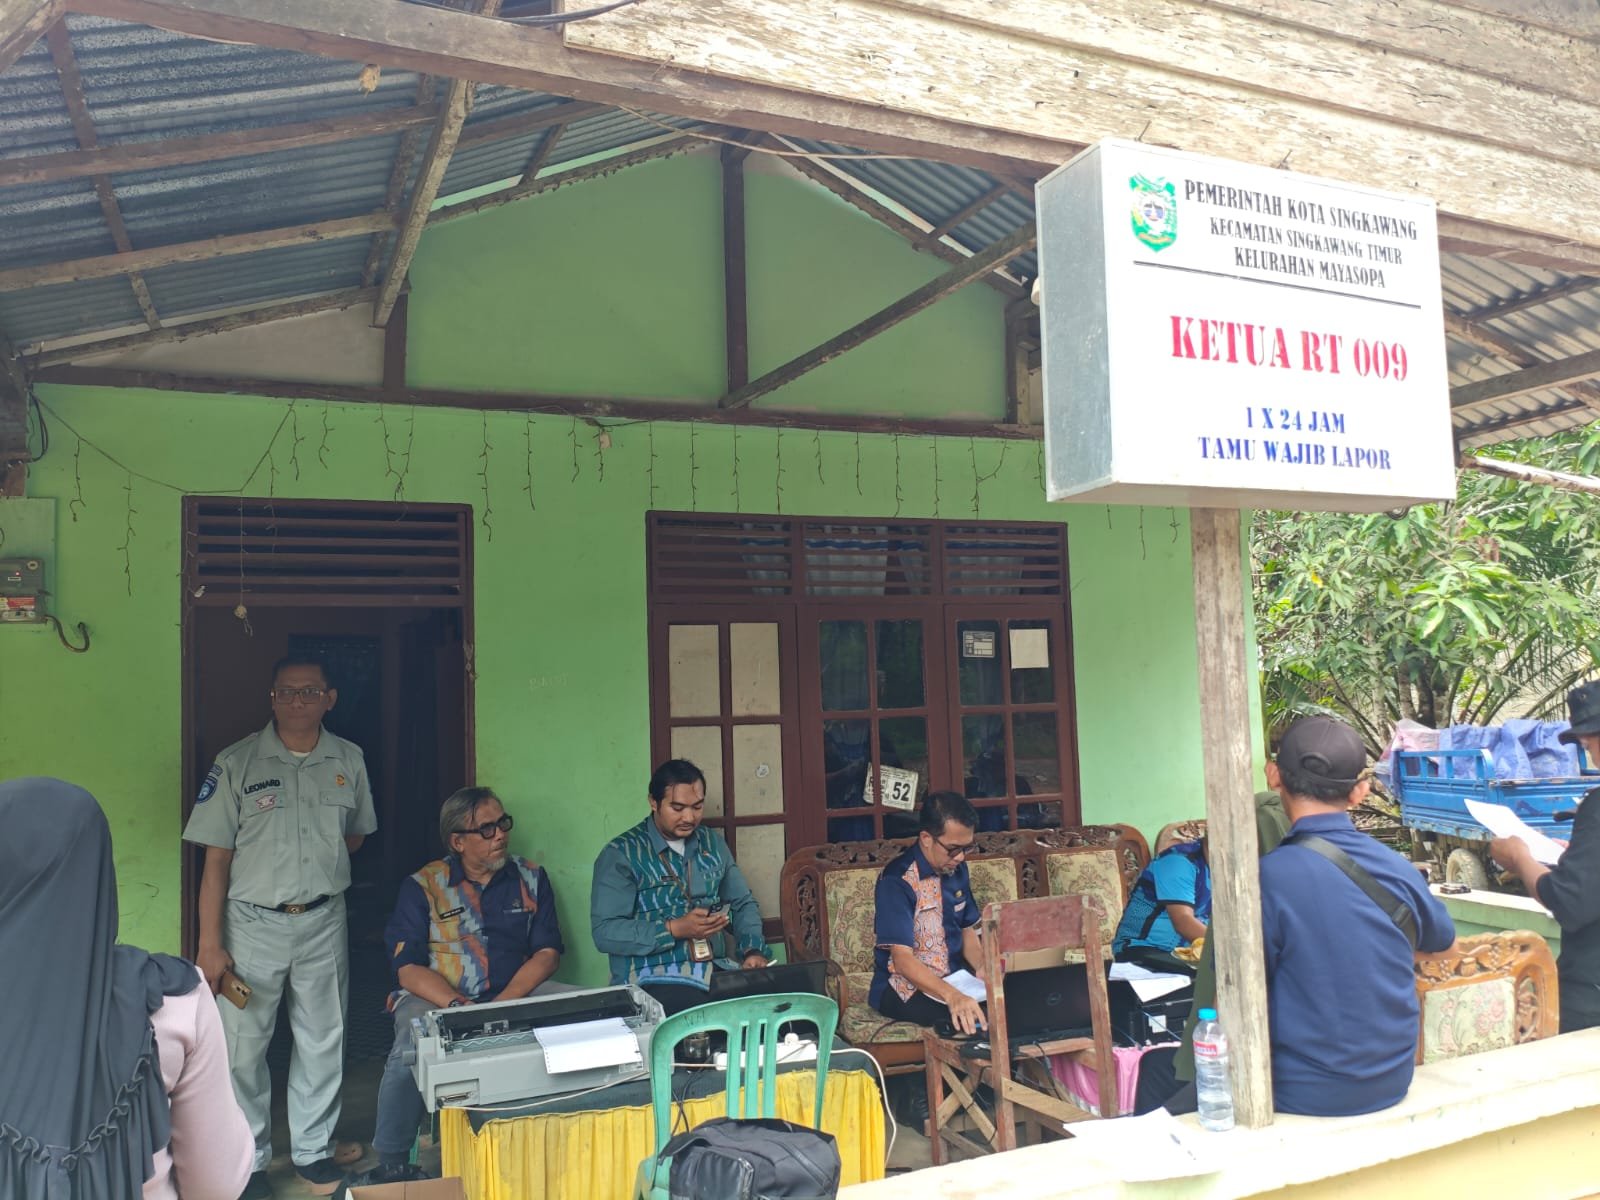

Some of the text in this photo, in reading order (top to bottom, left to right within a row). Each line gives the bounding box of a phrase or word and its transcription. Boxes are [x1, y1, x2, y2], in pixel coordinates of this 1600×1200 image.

[1185, 179, 1417, 241] PEMERINTAH KOTA SINGKAWANG
[1210, 217, 1402, 265] KECAMATAN SINGKAWANG TIMUR
[1234, 246, 1385, 289] KELURAHAN MAYASOPA
[1170, 315, 1408, 382] KETUA RT 009
[1246, 406, 1346, 434] 1 X 24 JAM
[1198, 436, 1391, 470] TAMU WAJIB LAPOR
[244, 779, 281, 795] LEONARD
[892, 781, 911, 802] 52
